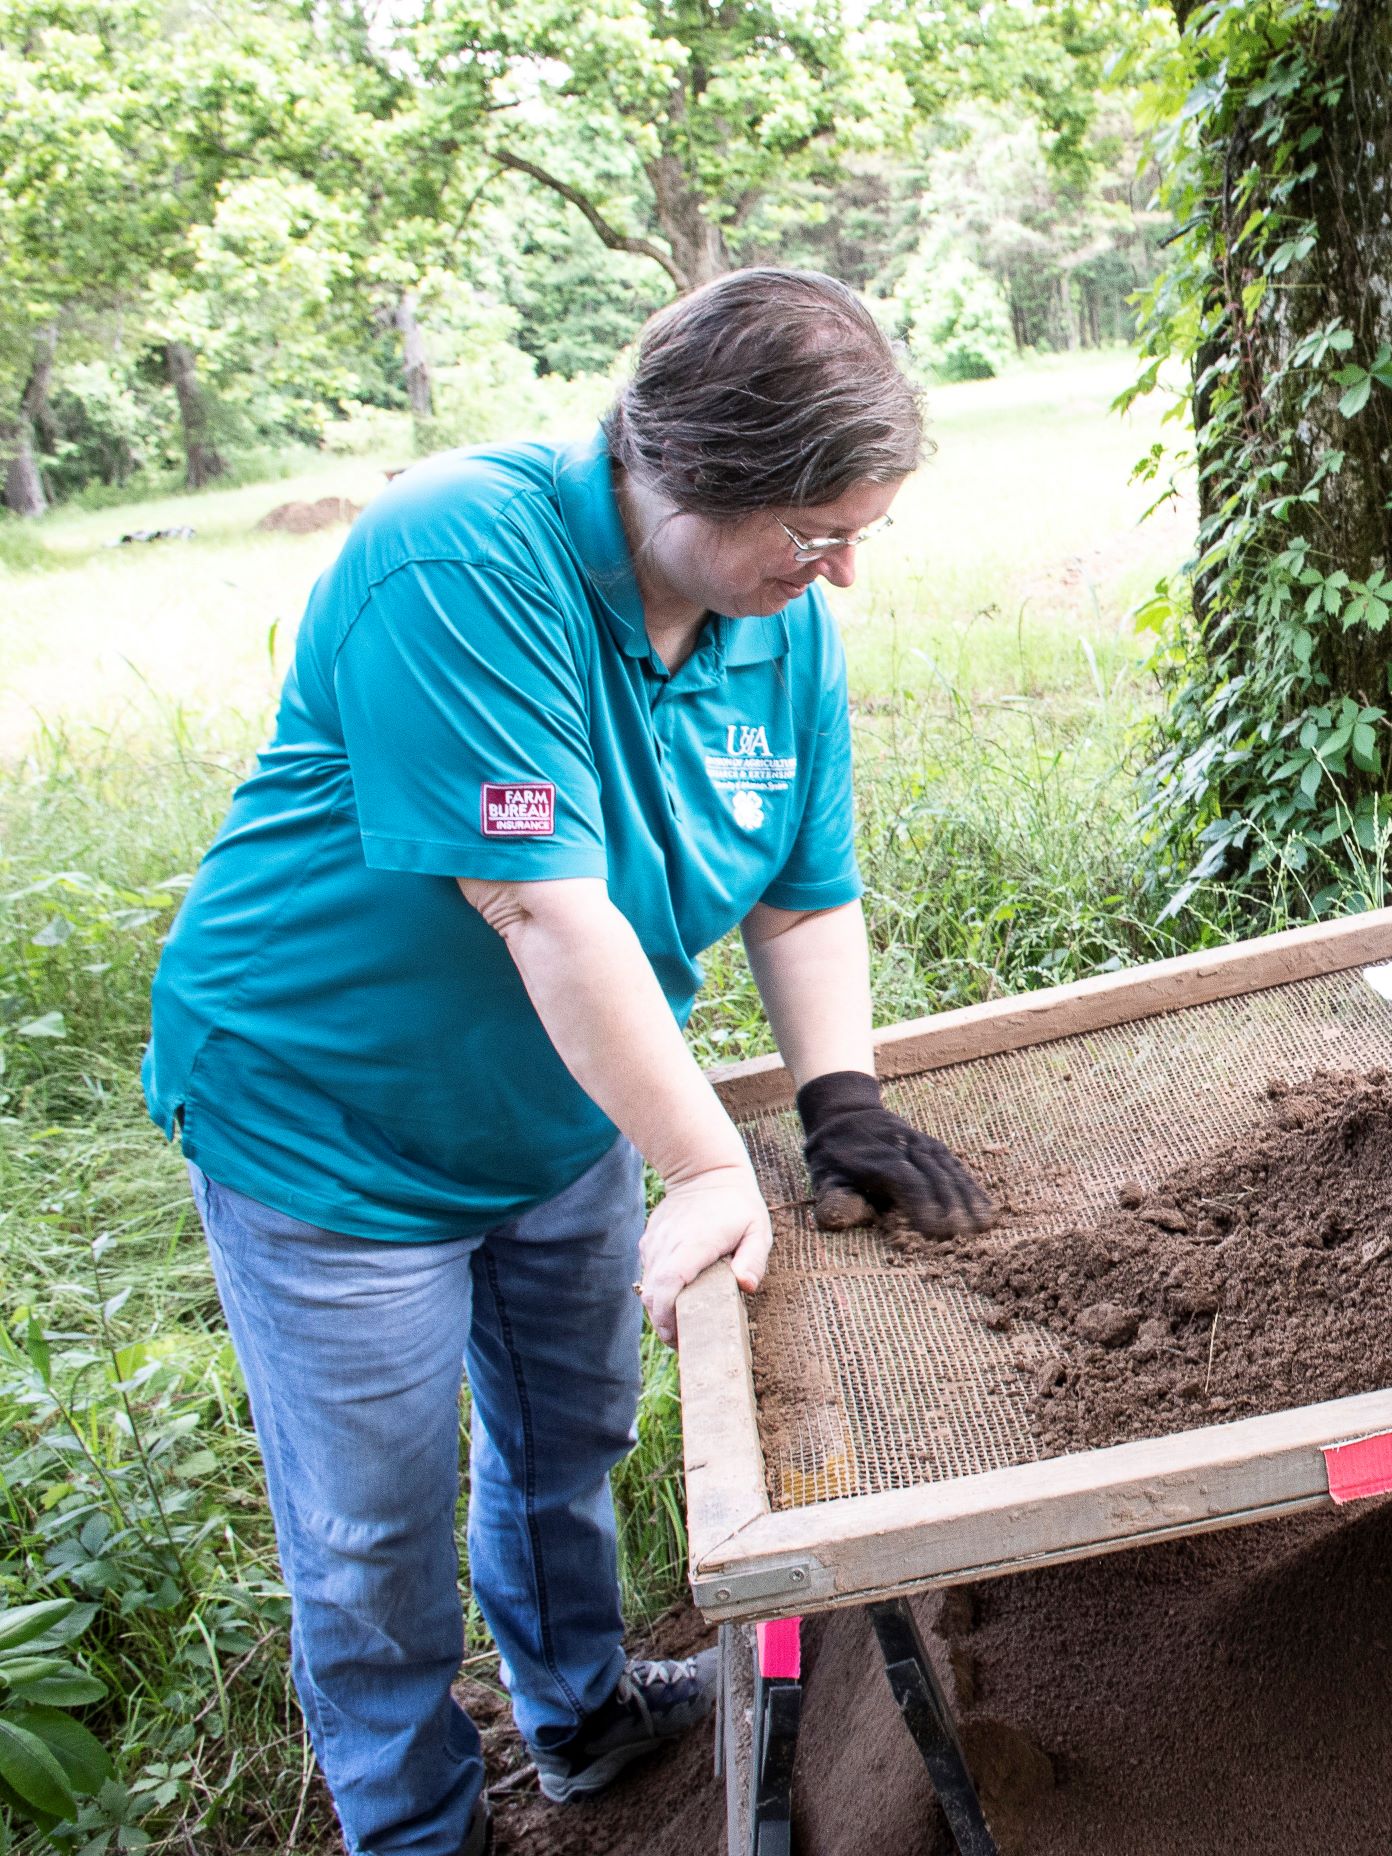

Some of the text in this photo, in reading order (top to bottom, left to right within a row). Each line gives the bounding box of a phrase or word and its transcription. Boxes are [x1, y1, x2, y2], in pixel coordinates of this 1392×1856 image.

[504, 790, 549, 804] FARM
[488, 803, 550, 818] BUREAU
[496, 820, 550, 830] INSURANCE
